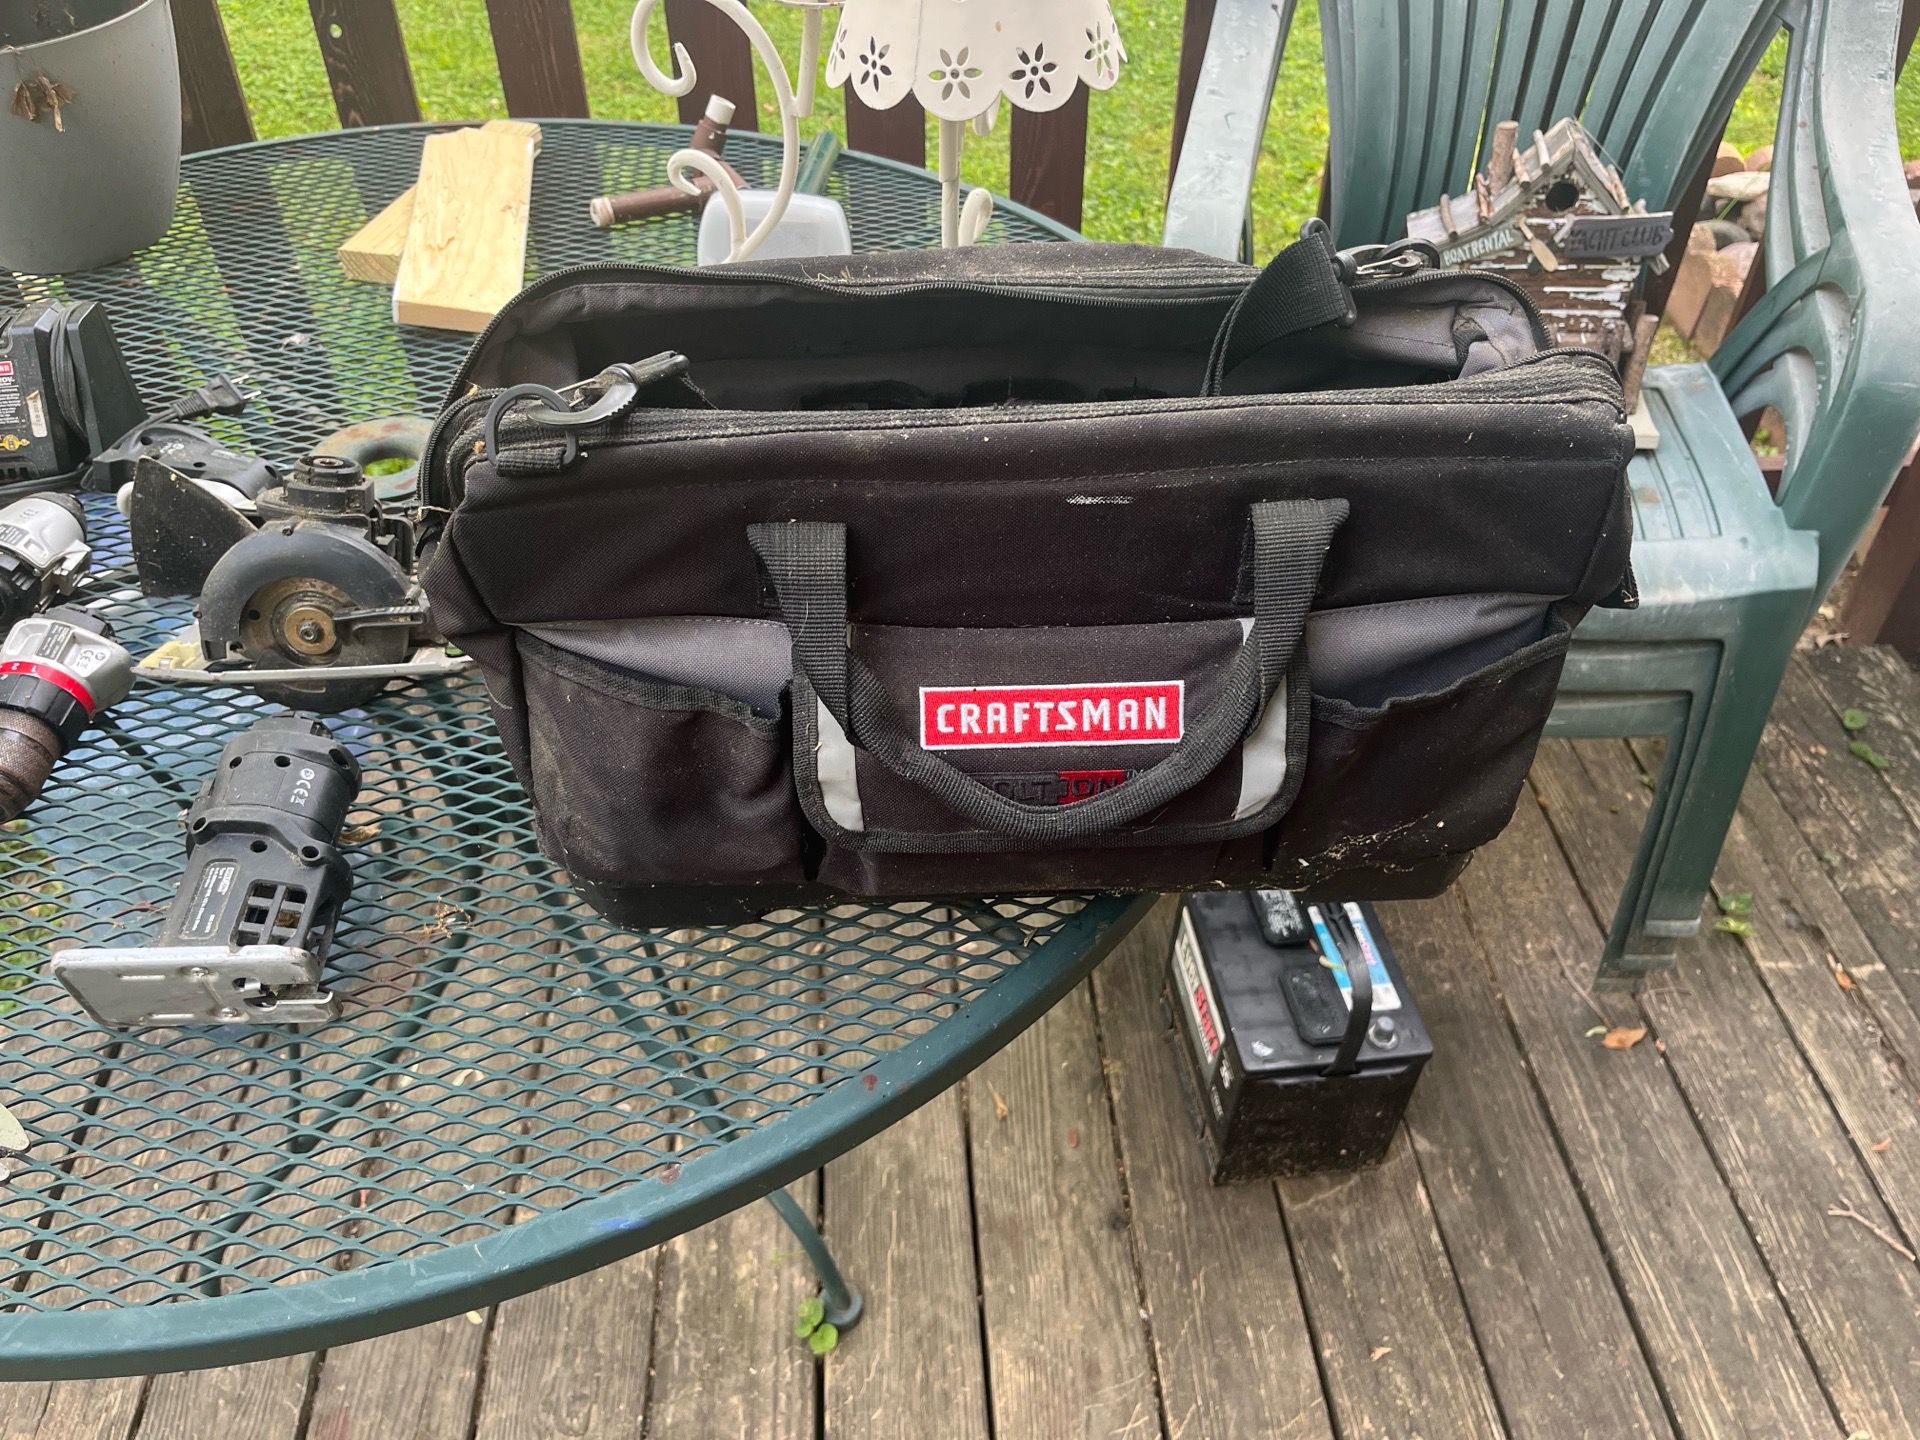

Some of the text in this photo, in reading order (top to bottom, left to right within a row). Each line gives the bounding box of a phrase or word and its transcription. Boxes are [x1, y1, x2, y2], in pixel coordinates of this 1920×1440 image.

[1443, 229, 1513, 266] BOAT RENTAL
[1621, 224, 1665, 247] CLUB
[936, 696, 1167, 735] CRAFTSMAN
